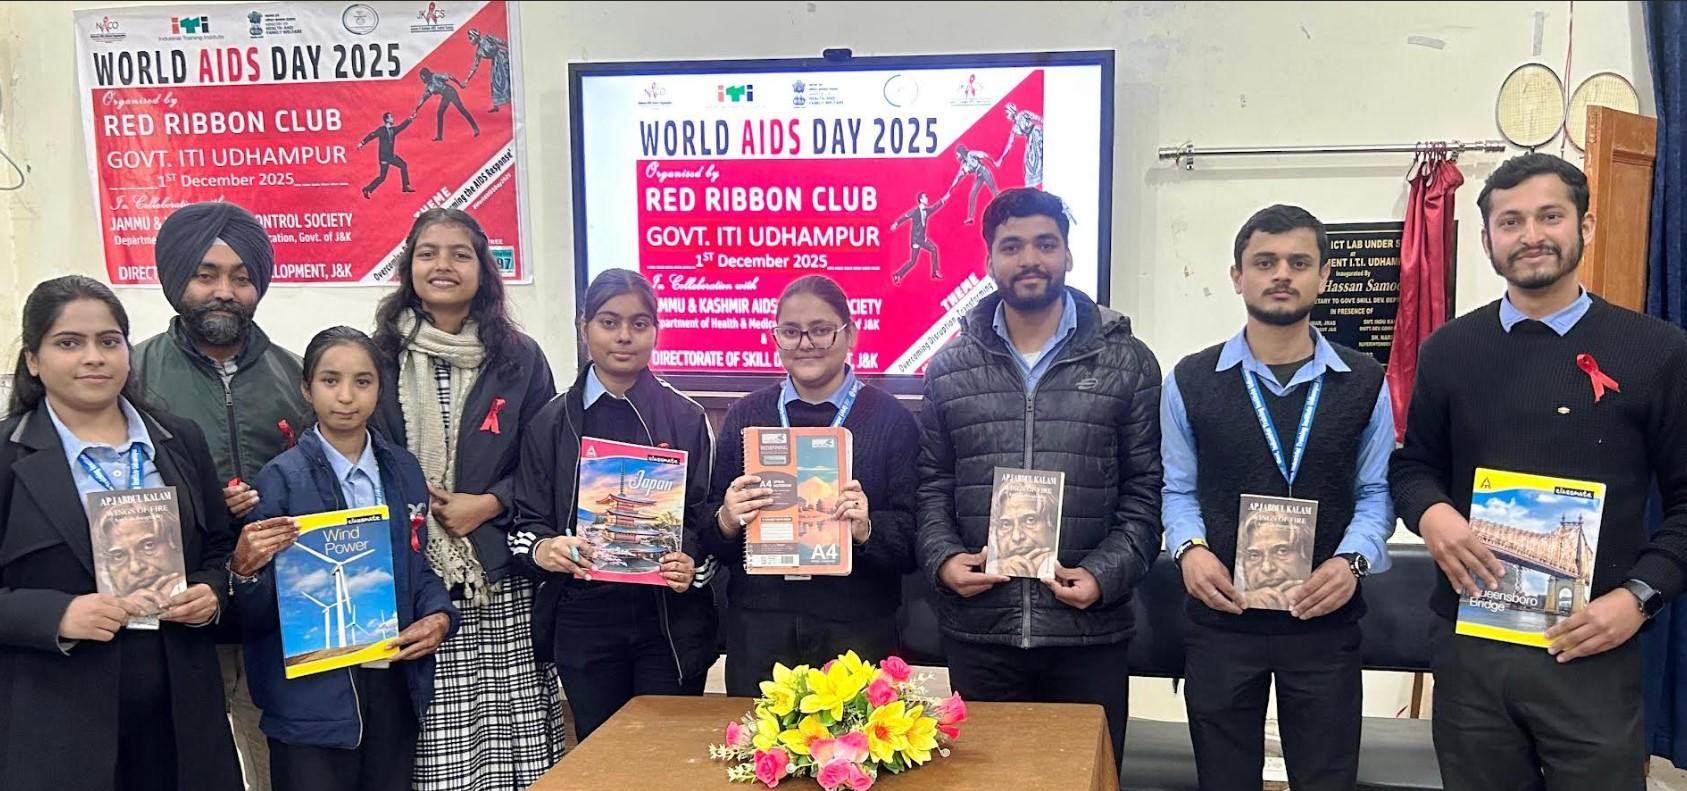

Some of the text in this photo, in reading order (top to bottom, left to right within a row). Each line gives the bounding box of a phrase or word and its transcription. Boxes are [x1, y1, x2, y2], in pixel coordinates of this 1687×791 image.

[93, 43, 401, 86] WORLD AIDS DAY 2025
[163, 91, 178, 108] by
[104, 108, 342, 136] RED RIBBON CLUB
[640, 117, 938, 156] WORLD AIDS DAY 2025
[107, 145, 347, 169] GOVT. ITI UDHAMPUR
[645, 160, 720, 183] Organised by
[181, 173, 255, 187] December
[464, 182, 477, 201] the
[473, 172, 489, 191] AIDS
[646, 186, 878, 212] RED RIBBON CLUB
[110, 216, 162, 231] JAMMU &
[255, 212, 352, 229] ONTROL SOCIETY
[114, 235, 157, 247] Departme
[299, 232, 323, 242] Govt.
[324, 231, 333, 242] of
[335, 231, 353, 242] J&K
[646, 225, 880, 247] GOVT. ITI UDHAMPUR
[1331, 240, 1345, 249] ICT
[1346, 240, 1363, 249] LAB
[1364, 239, 1394, 249] UNDER
[717, 254, 790, 268] December
[118, 265, 158, 280] DIRECT
[331, 263, 353, 279] J&K
[1335, 269, 1371, 278] Inaugurated By
[668, 273, 733, 291] Collaboration
[735, 276, 760, 290] with
[1324, 280, 1363, 293] Hassan
[940, 272, 980, 311] THEME
[687, 297, 698, 313] &
[699, 298, 750, 314] KASHMIR
[751, 298, 778, 314] AIDS
[659, 318, 700, 330] partment
[700, 319, 710, 329] of
[711, 318, 739, 329] Health
[740, 318, 748, 329] &
[863, 319, 881, 331] J&K
[898, 282, 995, 373] Overcoming Disruption Transforming
[760, 333, 768, 345] &
[651, 350, 724, 367] DIRECTORATE
[725, 351, 741, 367] OF
[742, 351, 772, 368] SKILL
[857, 352, 878, 369] J&K
[629, 469, 673, 496] Japan
[760, 480, 772, 488] A4
[1033, 475, 1057, 485] KALAM
[144, 491, 172, 502] KALAM
[150, 504, 169, 512] FIRE
[1286, 505, 1312, 515] KALAM
[323, 526, 360, 542] Wind
[324, 540, 369, 555] Power
[811, 543, 838, 560] A4
[1469, 597, 1505, 612] Bridge
[1480, 590, 1538, 607] ueensboro
